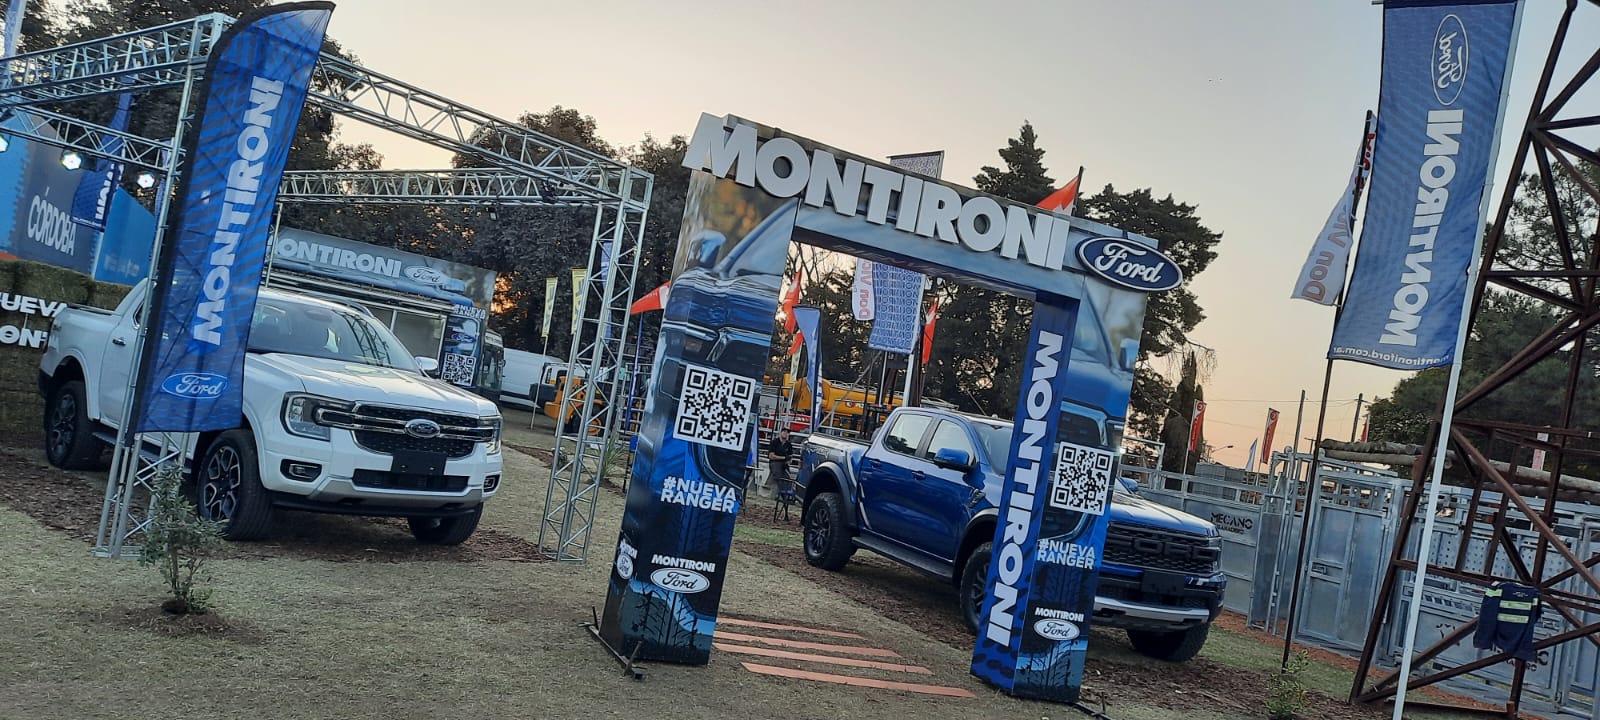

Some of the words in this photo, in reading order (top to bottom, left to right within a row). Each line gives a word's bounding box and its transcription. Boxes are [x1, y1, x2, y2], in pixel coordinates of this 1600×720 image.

[682, 112, 1070, 270] MONTIRONI
[193, 76, 284, 346] MONTIRONI
[1093, 241, 1166, 286] Ford
[175, 373, 227, 397] Ford
[660, 488, 734, 513] RANGER
[663, 476, 736, 501] #NUEVA
[987, 330, 1063, 647] MONTIRONI
[1037, 549, 1094, 570] RANGER
[1038, 538, 1096, 559] #NUEVA
[651, 554, 716, 573] MONTIRONI
[1035, 607, 1085, 622] MONTIRONI
